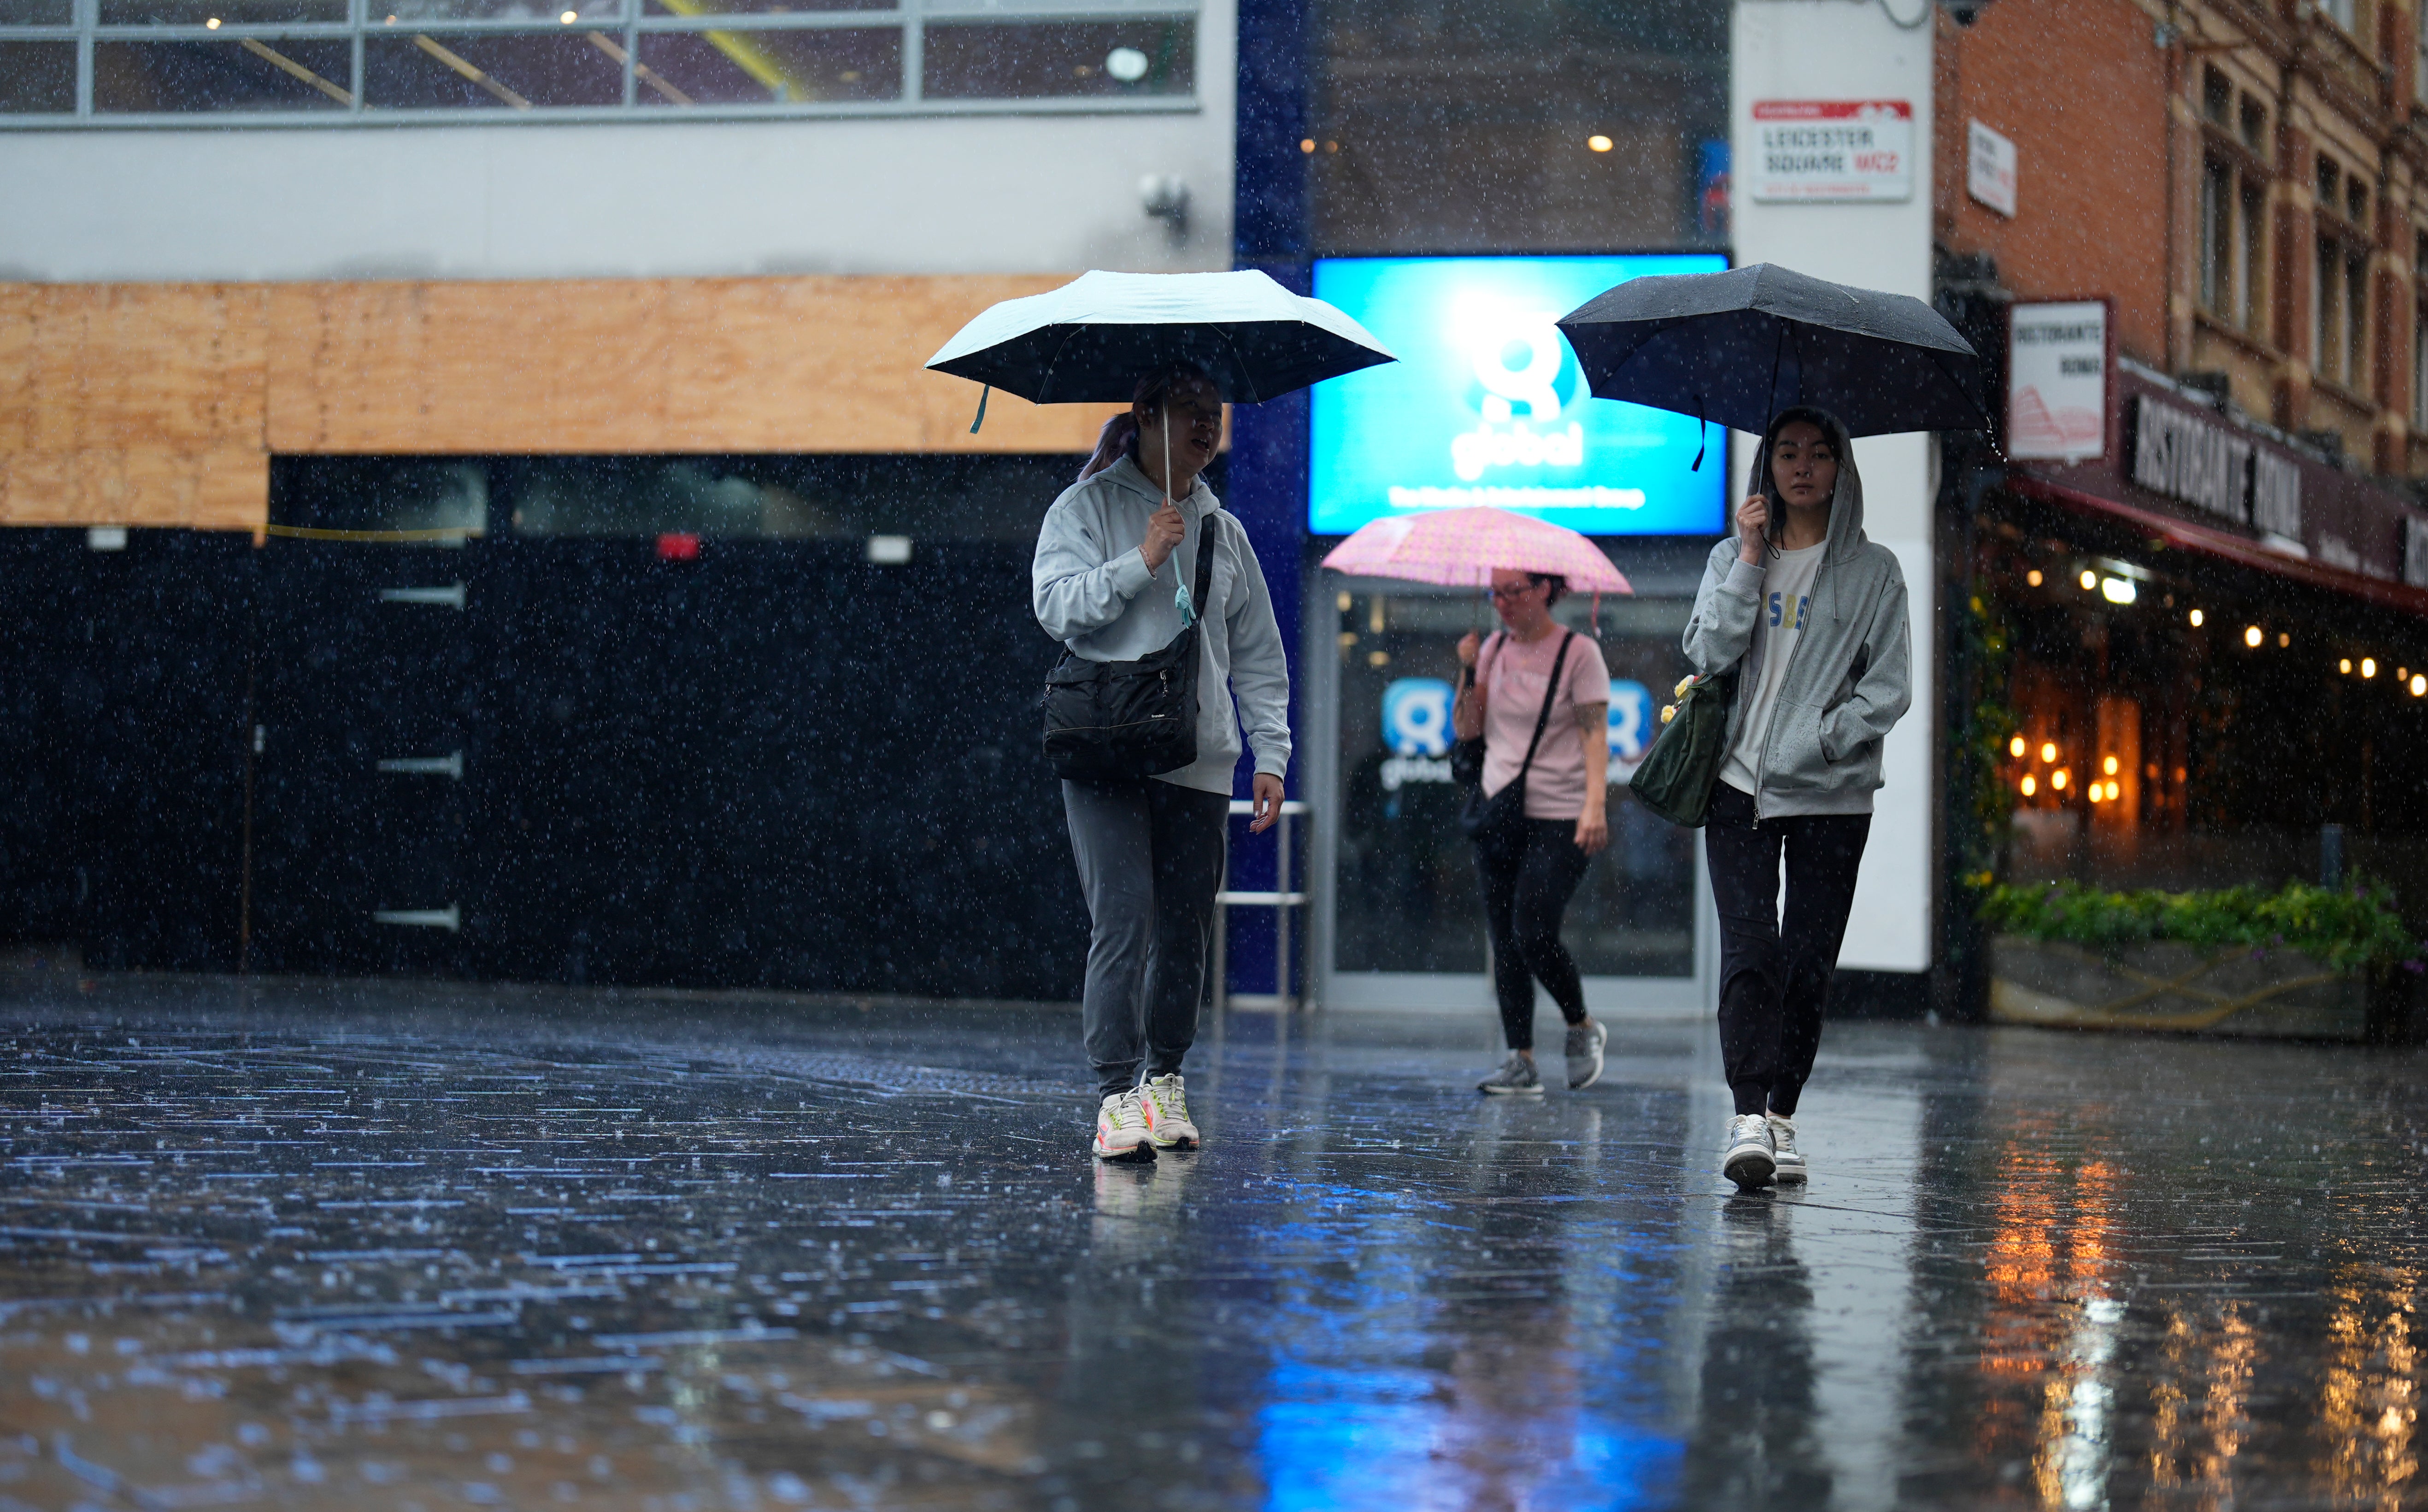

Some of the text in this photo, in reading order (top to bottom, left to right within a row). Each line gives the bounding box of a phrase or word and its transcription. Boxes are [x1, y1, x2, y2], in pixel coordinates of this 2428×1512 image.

[1764, 127, 1874, 147] LEICESTER
[1767, 152, 1899, 173] SQUARE WC2
[1451, 420, 1583, 482] global
